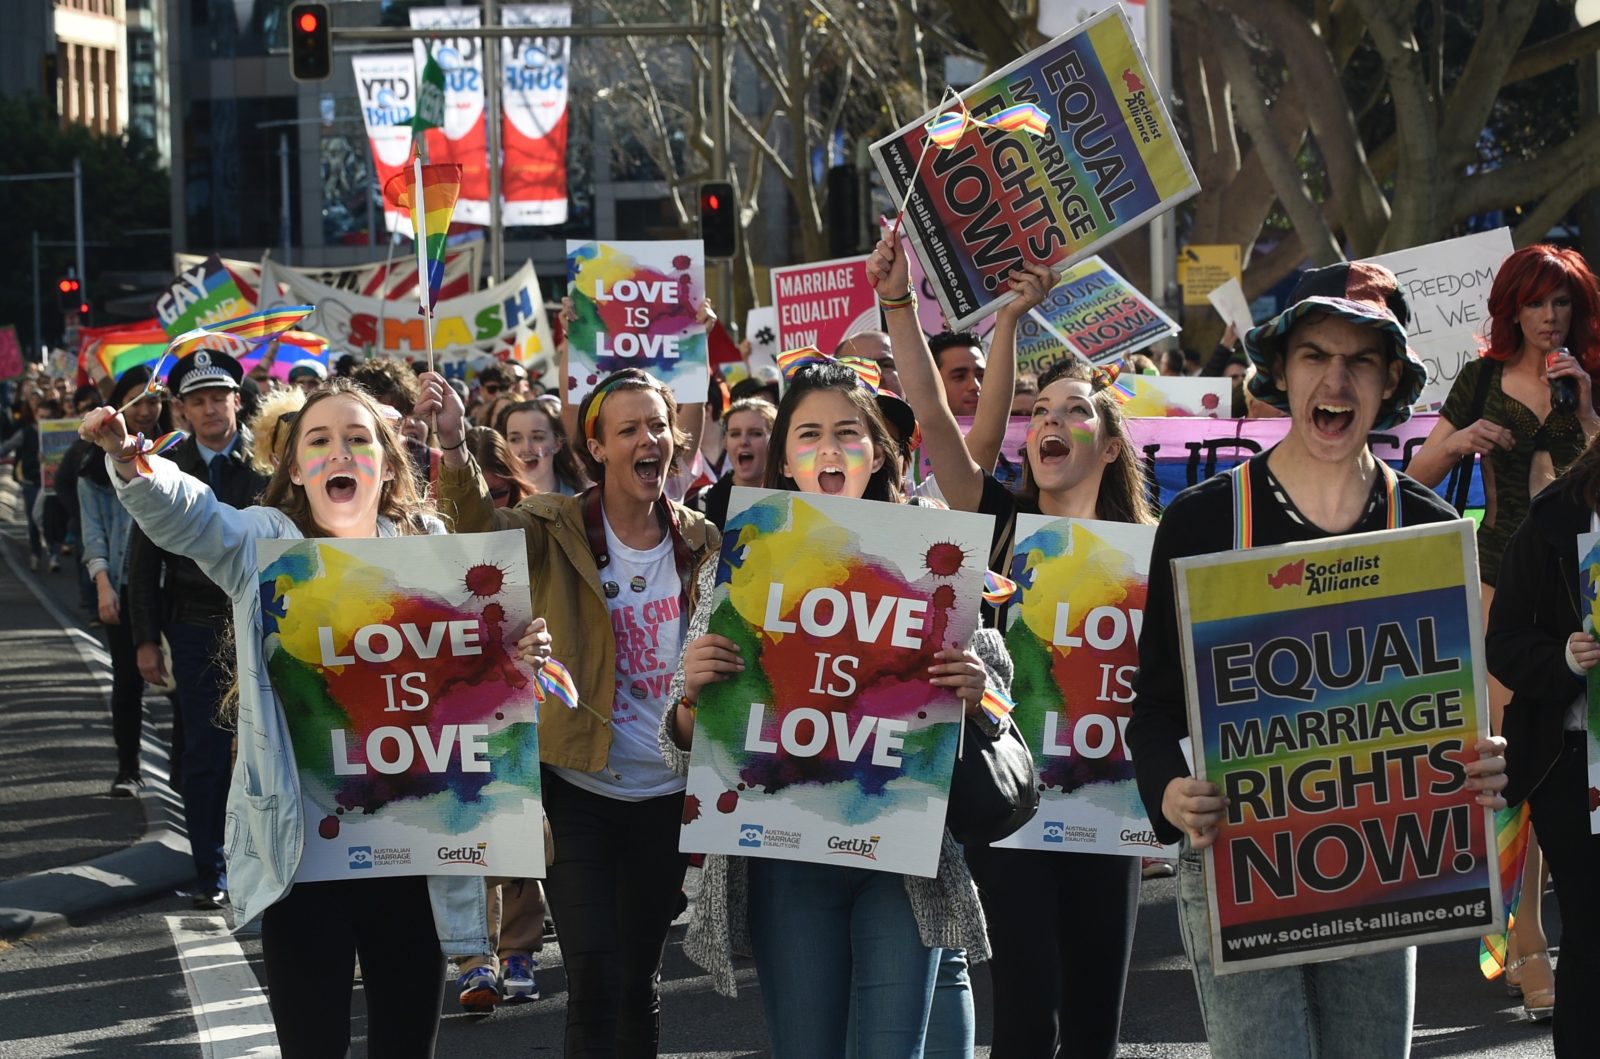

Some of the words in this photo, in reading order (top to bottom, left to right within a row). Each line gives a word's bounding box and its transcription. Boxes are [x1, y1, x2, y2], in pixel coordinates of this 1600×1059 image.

[1041, 49, 1137, 224] EQUAL
[1125, 97, 1151, 144] Alliance
[1133, 90, 1162, 140] Socialist
[1007, 76, 1097, 240] MRRIAGE
[888, 143, 973, 314] www.socialist-alliance.org
[156, 266, 209, 326] GAY
[594, 278, 679, 305] LOVE
[779, 267, 855, 299] MARRIAGE
[1041, 276, 1114, 313] EQUAL
[347, 286, 533, 351] SMASH
[624, 306, 650, 328] IS
[781, 296, 851, 327] EQUALITY
[1052, 287, 1126, 324] MARRIAGE
[1062, 296, 1139, 335] RIGHTS
[595, 330, 680, 359] LOVE
[783, 329, 818, 352] NOW
[1076, 308, 1159, 350] NOW!
[1304, 555, 1380, 581] Socialist
[1306, 574, 1380, 596] Alliance
[762, 582, 929, 651] LOVE
[1052, 601, 1146, 651] LO
[317, 618, 484, 667] LOVE
[1210, 616, 1462, 706] EQUAL
[379, 671, 431, 713] IS
[808, 651, 860, 698] IS
[1095, 663, 1140, 704] IS
[743, 702, 909, 769] LOVE
[1042, 711, 1134, 762] LO
[1218, 690, 1465, 762] MARRIAGE
[330, 723, 491, 777] LOVE
[1223, 739, 1468, 826] RIGHTS
[374, 847, 412, 855] AUSTRALIAN
[763, 841, 801, 849] EQUALITY.ORG
[764, 834, 801, 844] MARRIAGE
[765, 829, 802, 838] AUSTRALIAN
[1229, 804, 1476, 907] NOW!
[374, 853, 412, 861] MARRIAGE
[1226, 900, 1487, 952] www.socialist-alliance.org
